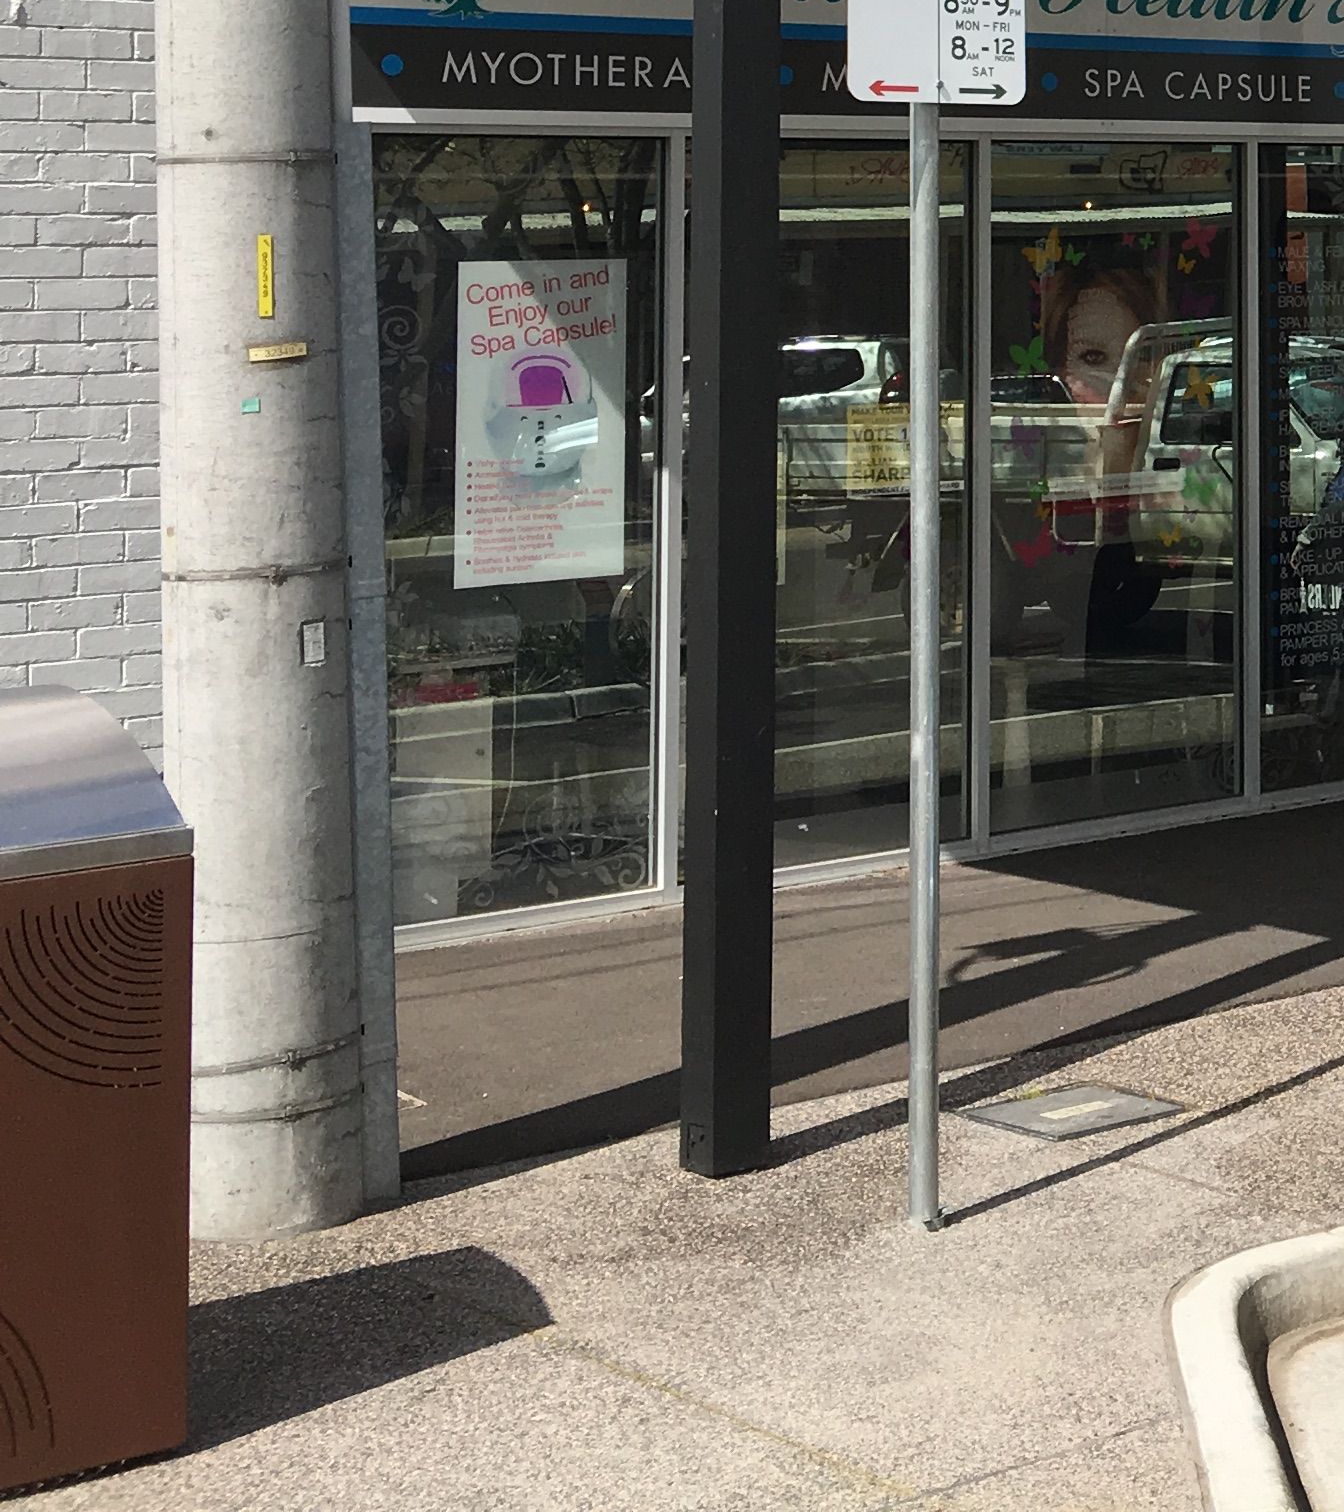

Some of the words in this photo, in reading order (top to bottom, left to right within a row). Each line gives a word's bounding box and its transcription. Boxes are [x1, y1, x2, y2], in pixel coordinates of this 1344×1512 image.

[956, 20, 980, 31] MON
[993, 22, 1010, 32] FRI
[951, 36, 966, 60] 8
[994, 38, 1015, 55] 12
[442, 52, 692, 88] MYOTHERA
[972, 67, 994, 76] SAT
[1084, 69, 1144, 99] SPA
[1165, 71, 1312, 104] CAPSULE
[466, 280, 535, 305] Come
[543, 274, 561, 293] in
[570, 264, 610, 289] and
[1278, 282, 1302, 294] EYE
[488, 303, 549, 328] Enjoy
[557, 296, 592, 316] our
[1278, 318, 1303, 330] SPA
[471, 335, 516, 358] Spa
[523, 314, 617, 347] Capsule!
[853, 427, 895, 442] VOTE
[1280, 530, 1288, 542] &
[1326, 546, 1342, 560] UP
[1280, 566, 1288, 579] &
[1280, 619, 1338, 636] PRINCESS
[1280, 635, 1329, 651] PAMPER
[1281, 652, 1296, 666] for
[1300, 651, 1328, 665] ages
